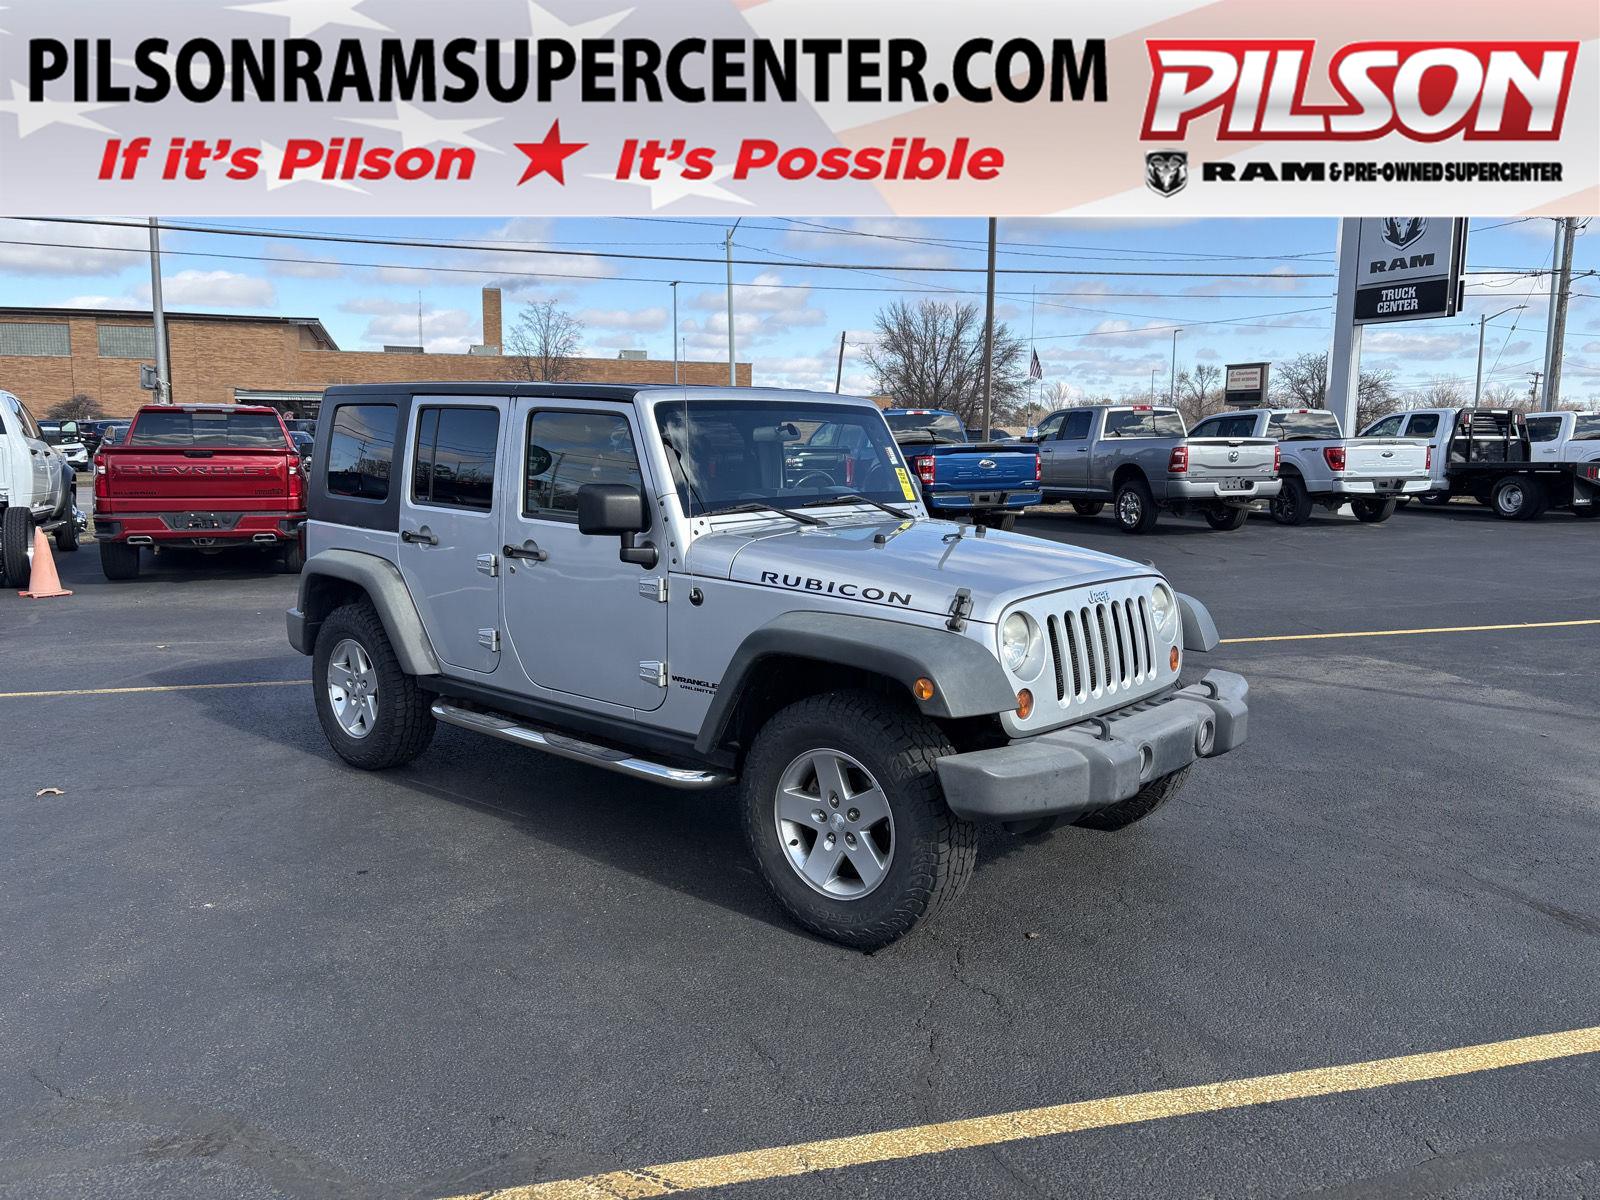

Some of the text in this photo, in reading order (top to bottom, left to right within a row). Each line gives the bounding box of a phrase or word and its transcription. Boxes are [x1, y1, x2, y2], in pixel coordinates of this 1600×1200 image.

[1370, 253, 1435, 274] RAM
[1381, 286, 1417, 301] TRUCK
[1377, 298, 1419, 314] CENTER
[120, 465, 276, 475] CHEVROLET
[761, 571, 912, 606] RUBICON
